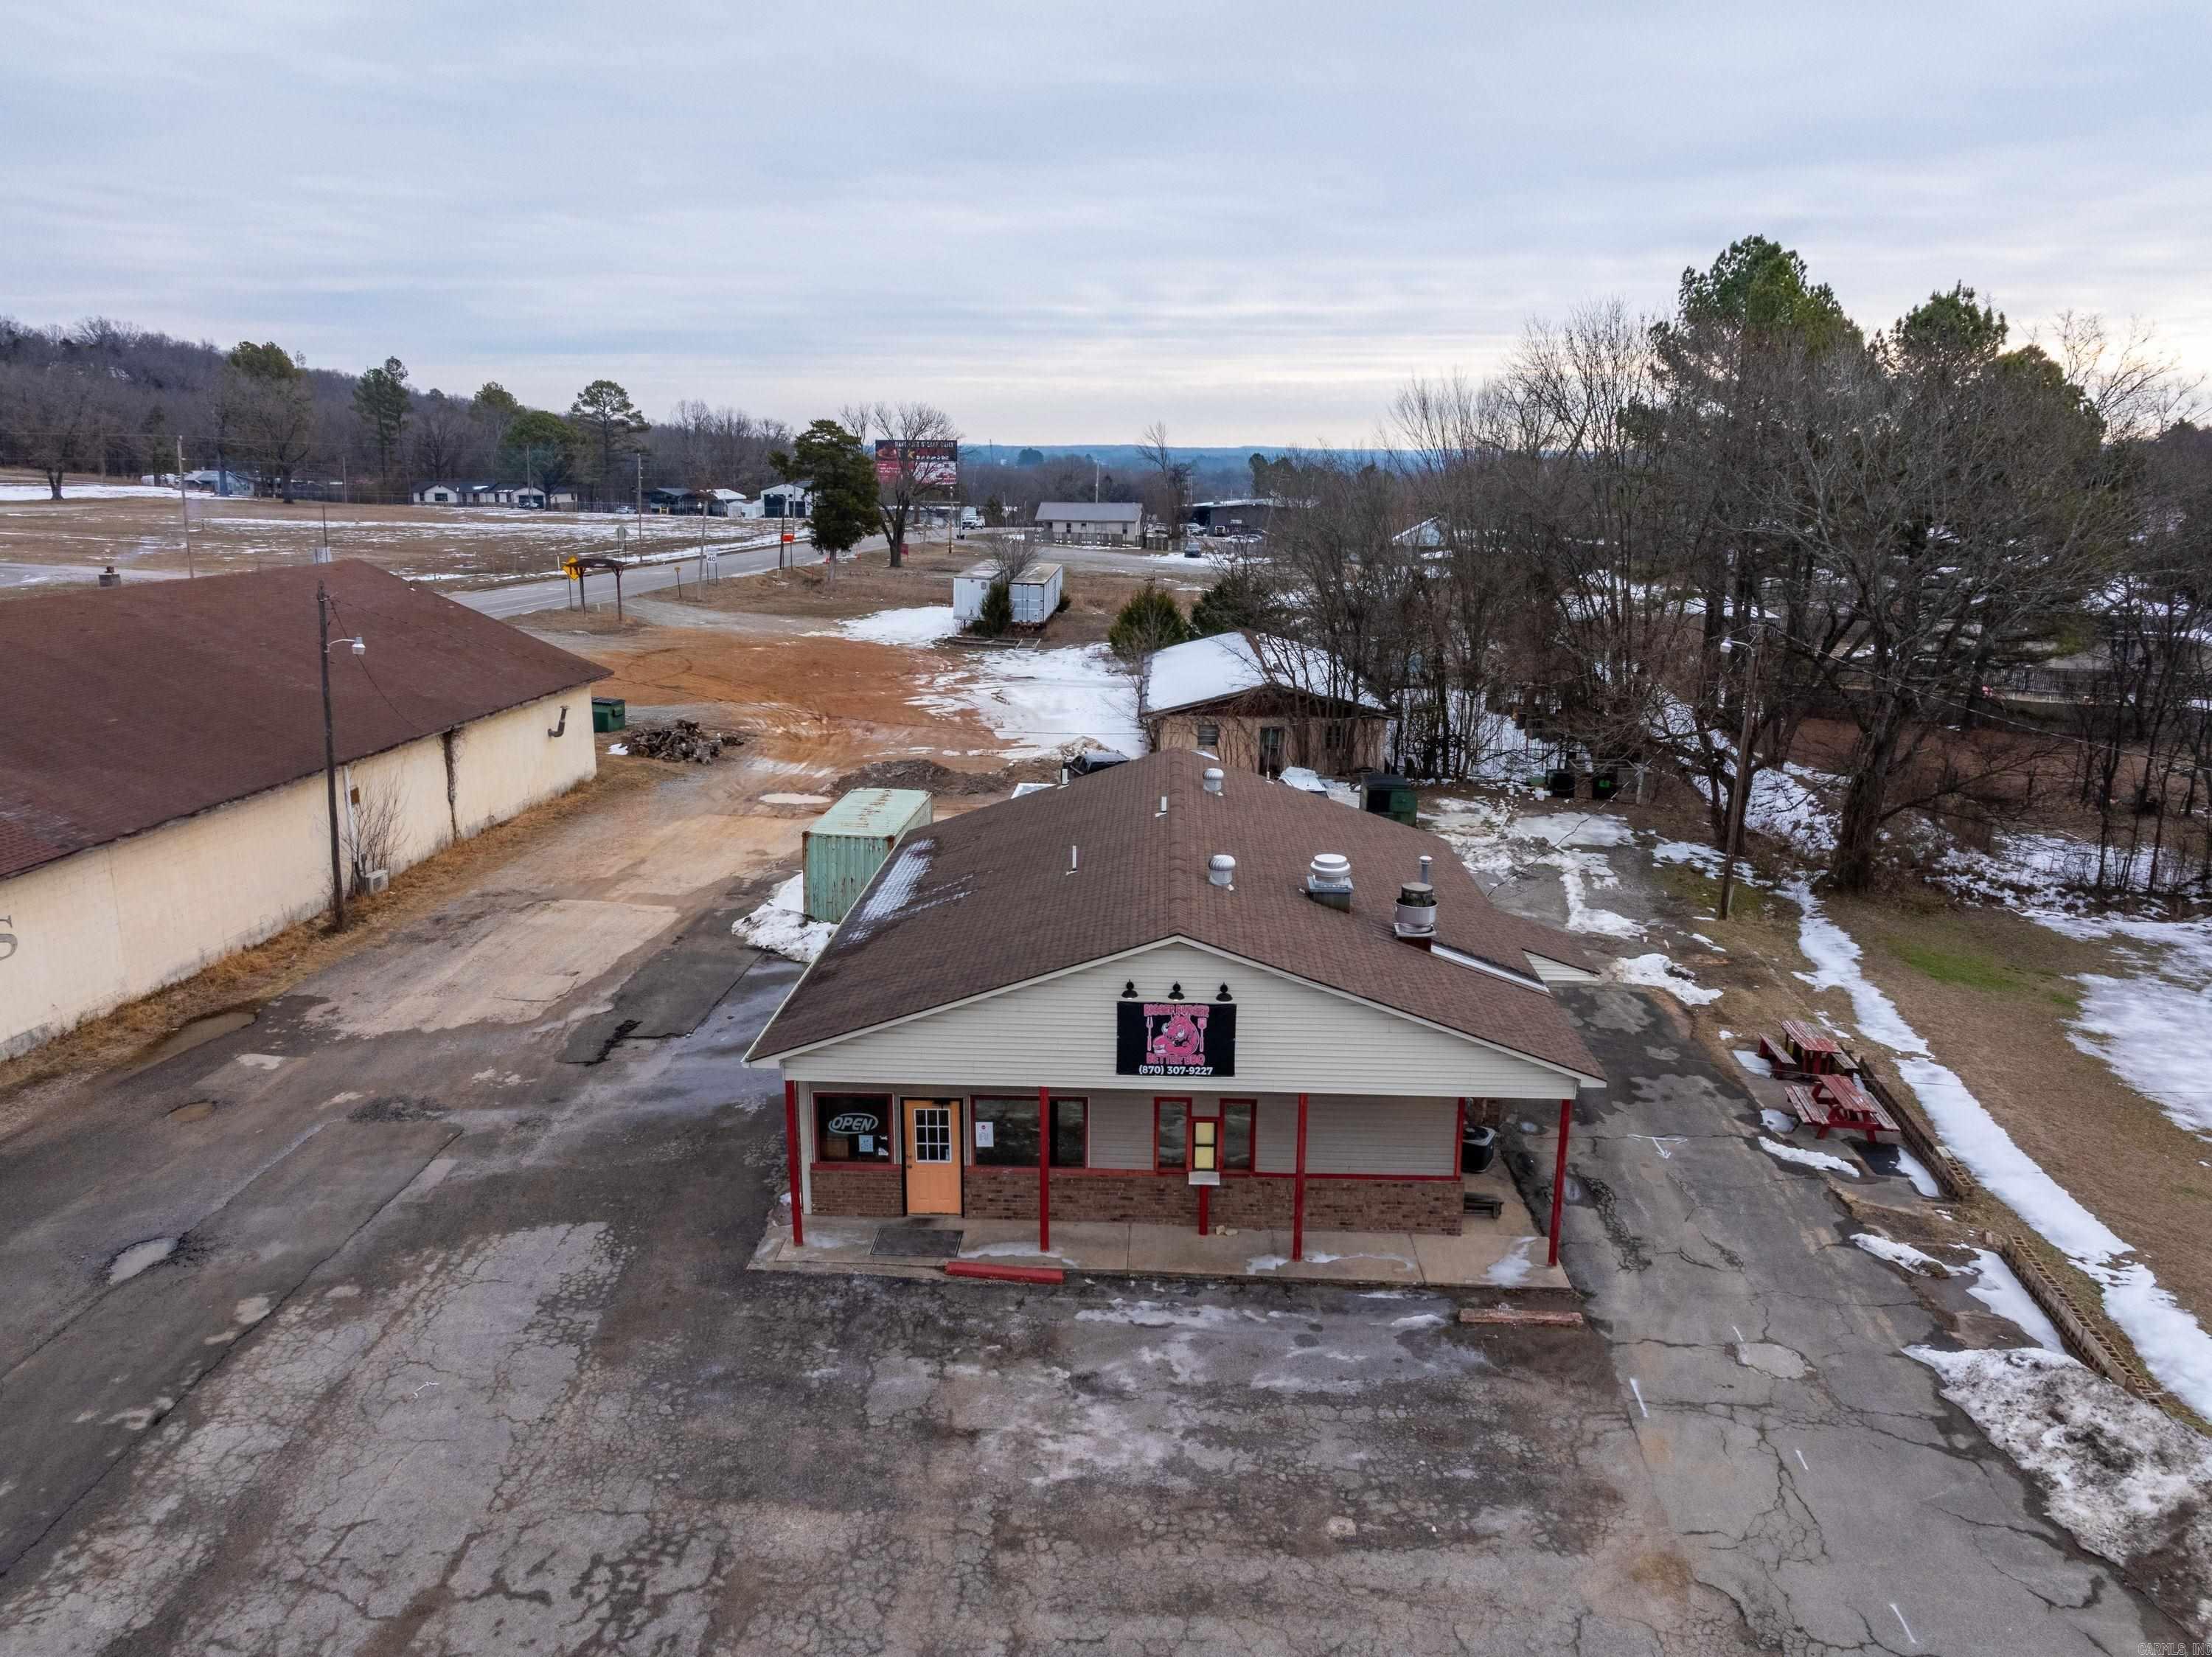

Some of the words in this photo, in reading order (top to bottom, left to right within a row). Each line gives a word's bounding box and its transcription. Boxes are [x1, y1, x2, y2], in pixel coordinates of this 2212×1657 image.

[1138, 1065, 1164, 1074] (870)
[1166, 1066, 1213, 1075] 307-9227
[832, 1116, 873, 1131] OPEN
